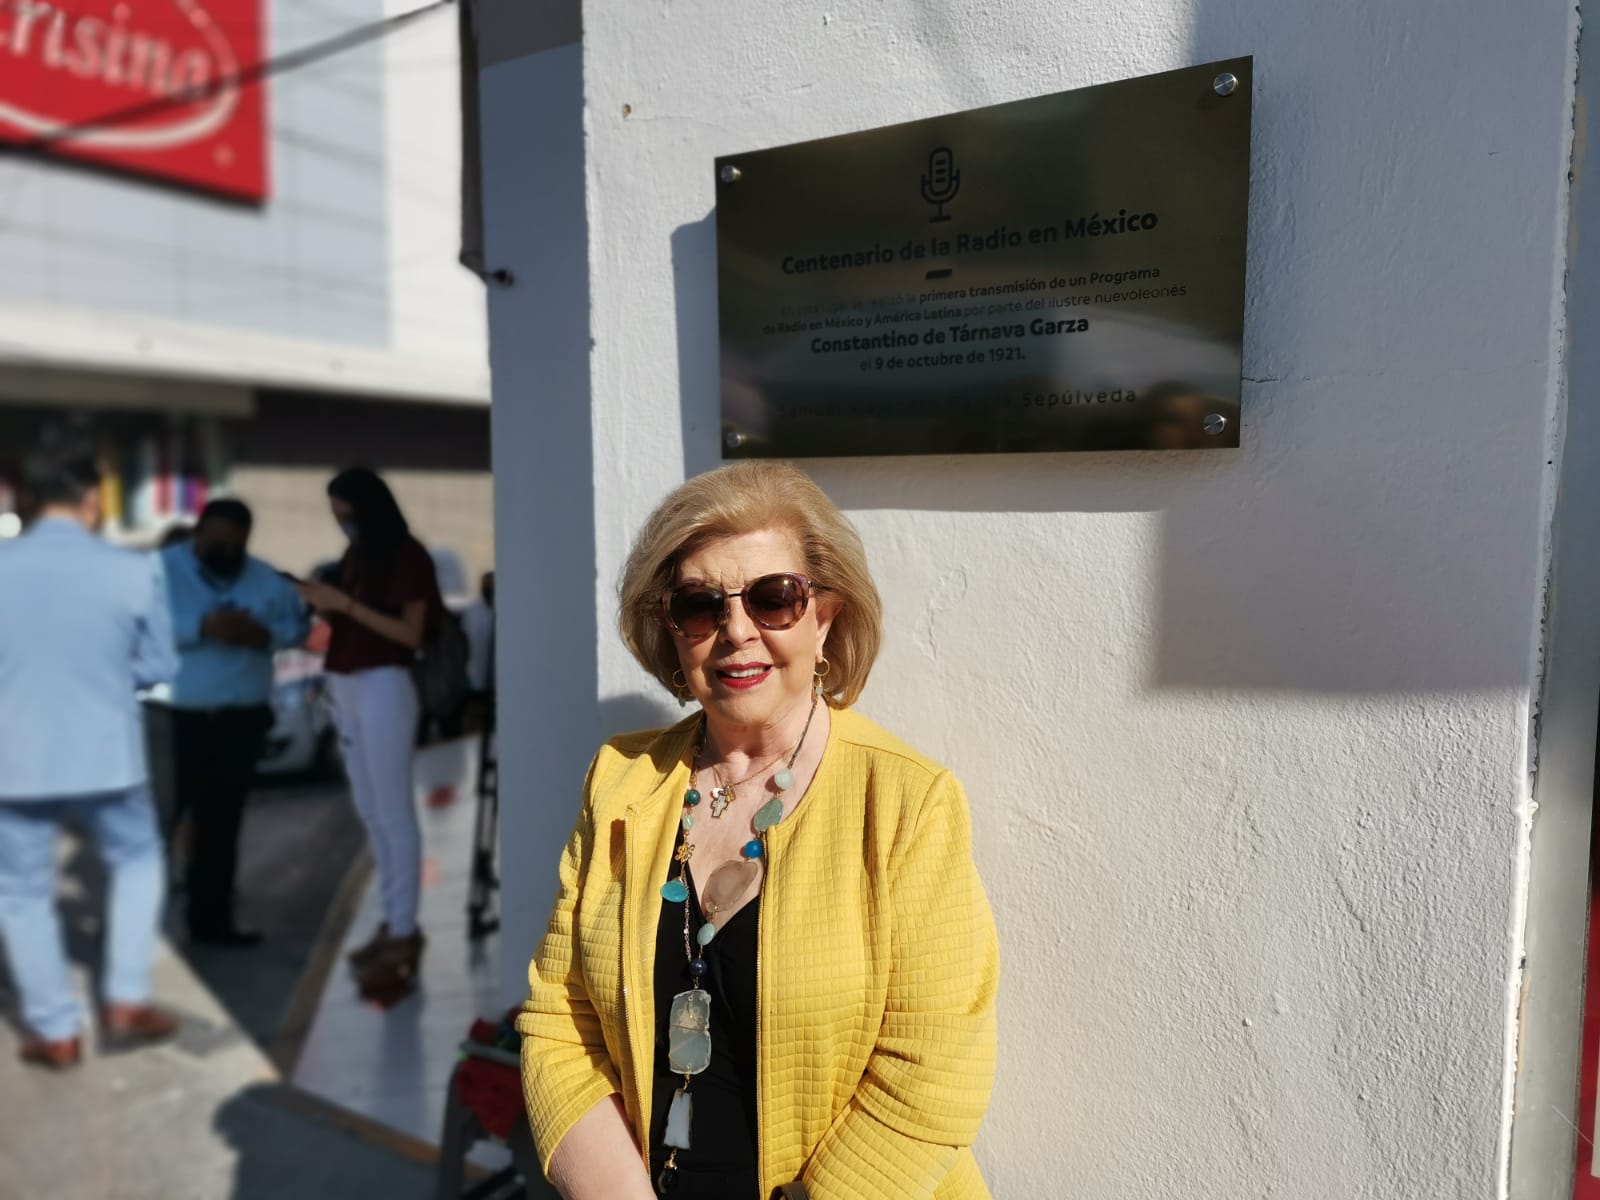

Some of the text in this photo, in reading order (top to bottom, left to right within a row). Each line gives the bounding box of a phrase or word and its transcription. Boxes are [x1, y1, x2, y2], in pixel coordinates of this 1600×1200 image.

[781, 207, 1158, 275] Centenario de la Radio en México
[919, 289, 966, 305] primera
[968, 277, 1046, 298] transmisión
[1049, 275, 1066, 290] de
[1068, 275, 1087, 287] un
[1089, 266, 1161, 286] Programa
[777, 320, 808, 334] Radio
[809, 320, 823, 332] en
[824, 316, 863, 330] México
[864, 315, 873, 329] y
[875, 311, 922, 326] América
[924, 305, 962, 321] Latina
[964, 304, 986, 320] por
[987, 300, 1022, 317] parte
[1025, 298, 1045, 312] del
[1048, 294, 1091, 310] ilustre
[1094, 283, 1188, 305] nuevoleonés
[809, 316, 1090, 355] Constantino de Tárnava Garza
[858, 345, 1027, 373] el 9 de octubre de 1921.
[1022, 386, 1137, 409] Sepúlveda
